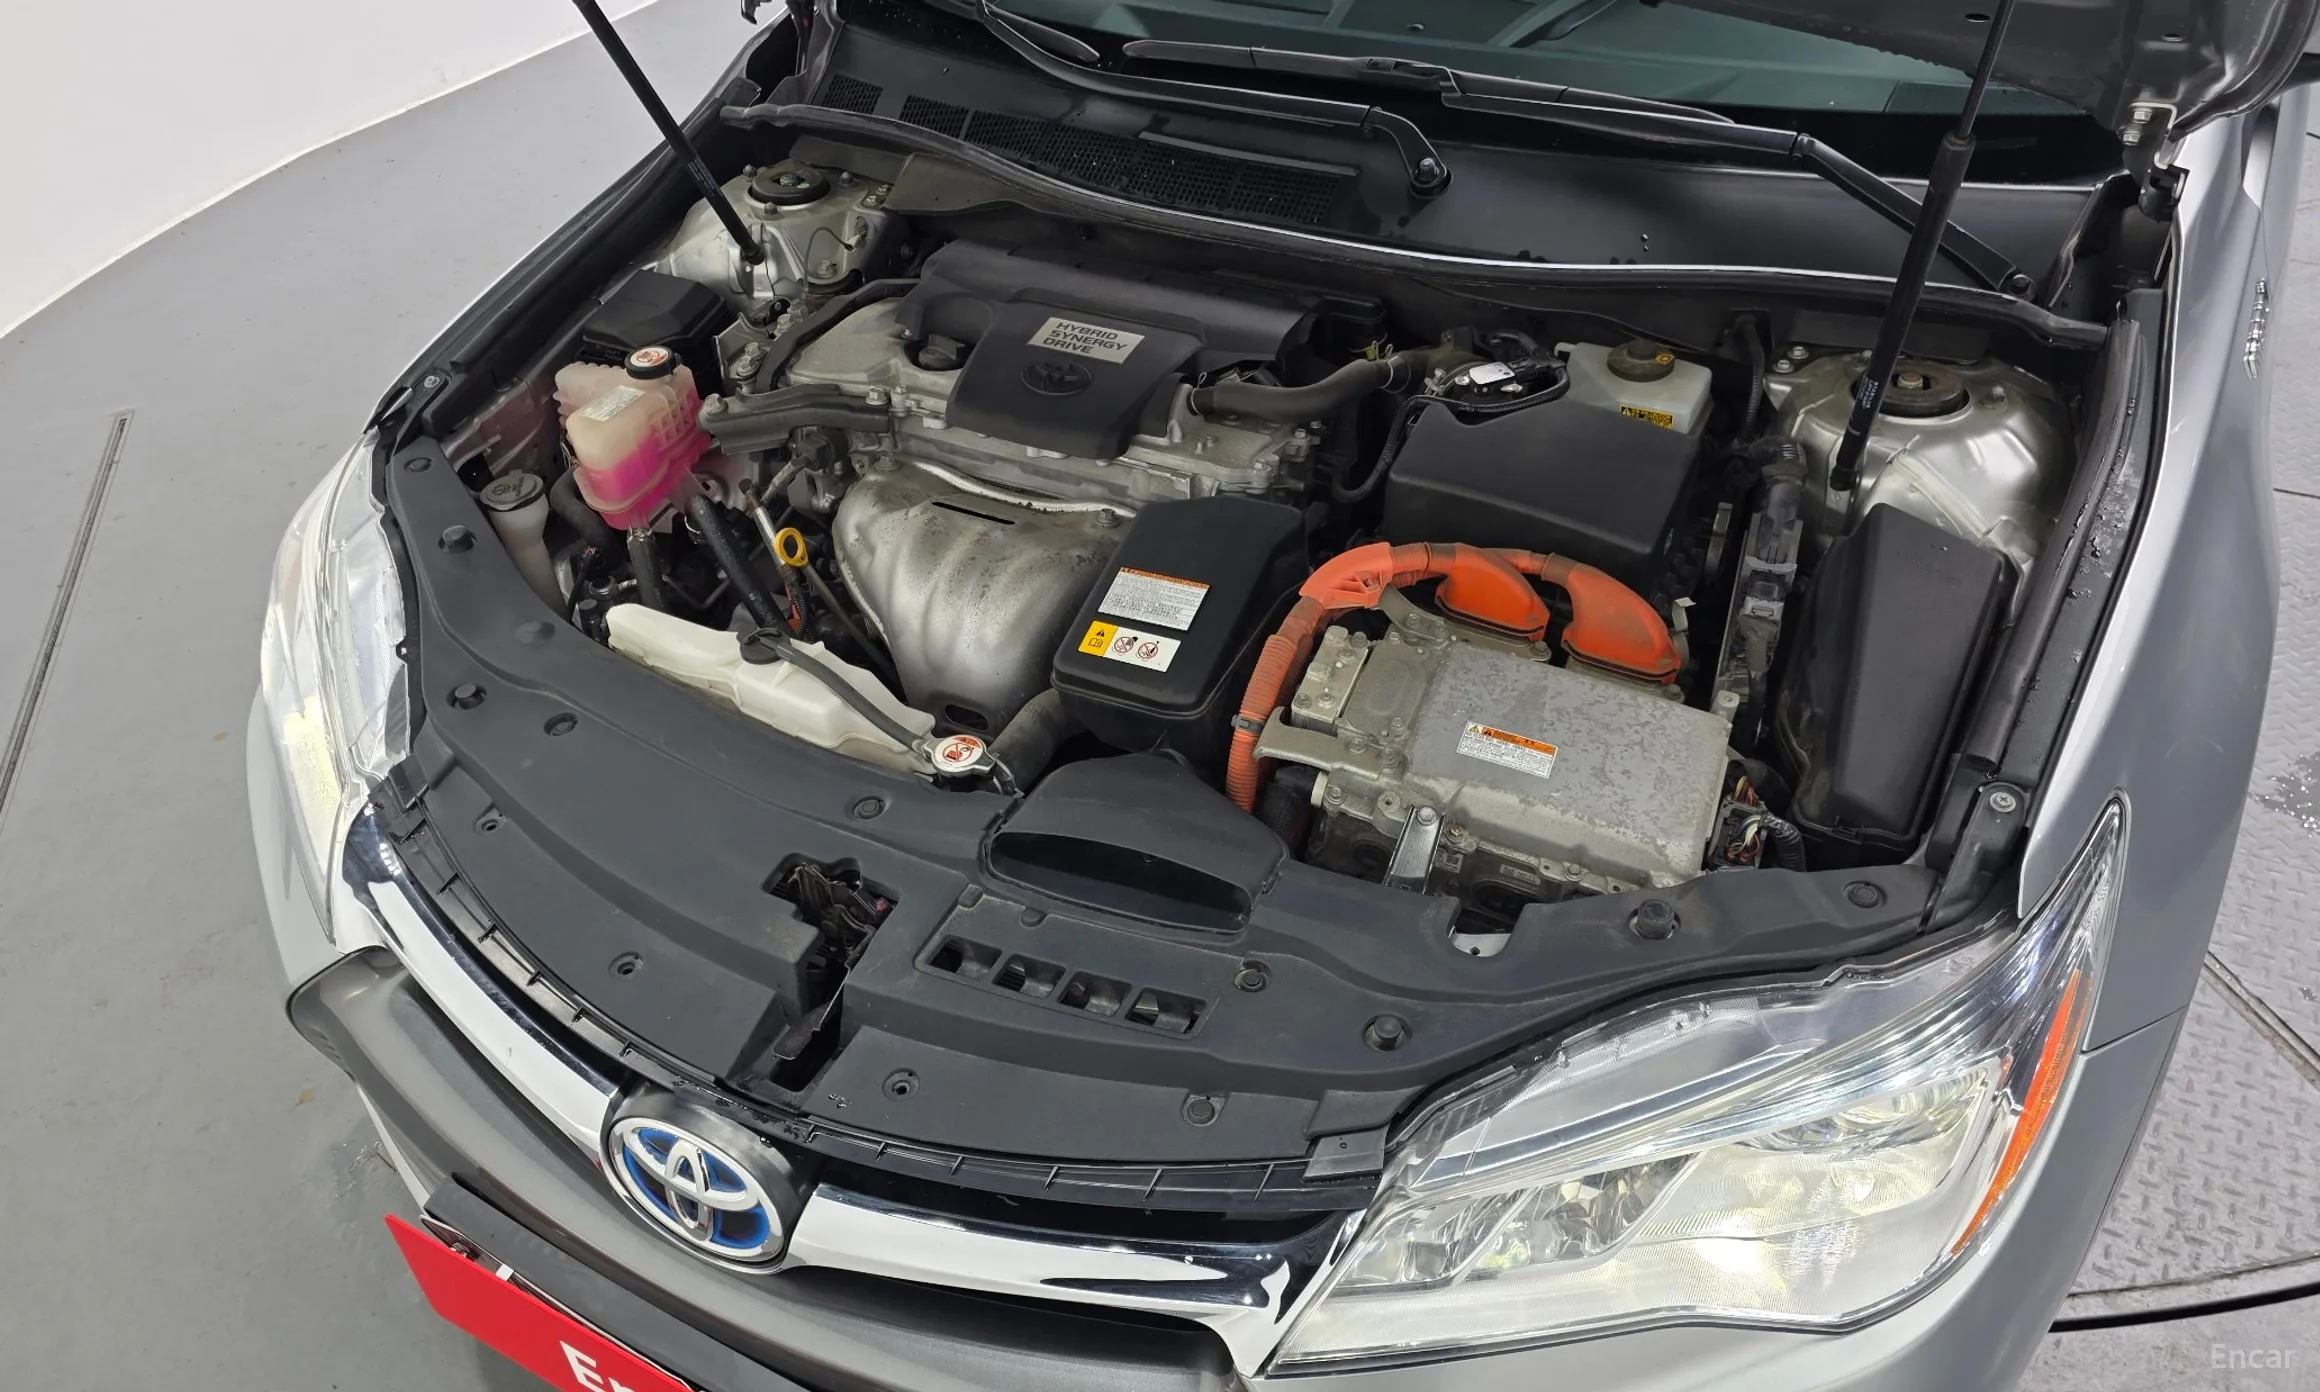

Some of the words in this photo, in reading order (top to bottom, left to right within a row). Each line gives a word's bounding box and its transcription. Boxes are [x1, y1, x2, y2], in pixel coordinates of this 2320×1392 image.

[1050, 330, 1128, 351] SYNERGY
[1056, 322, 1118, 340] HYBRID
[1043, 337, 1093, 354] DRIVE
[559, 1340, 637, 1392] E
